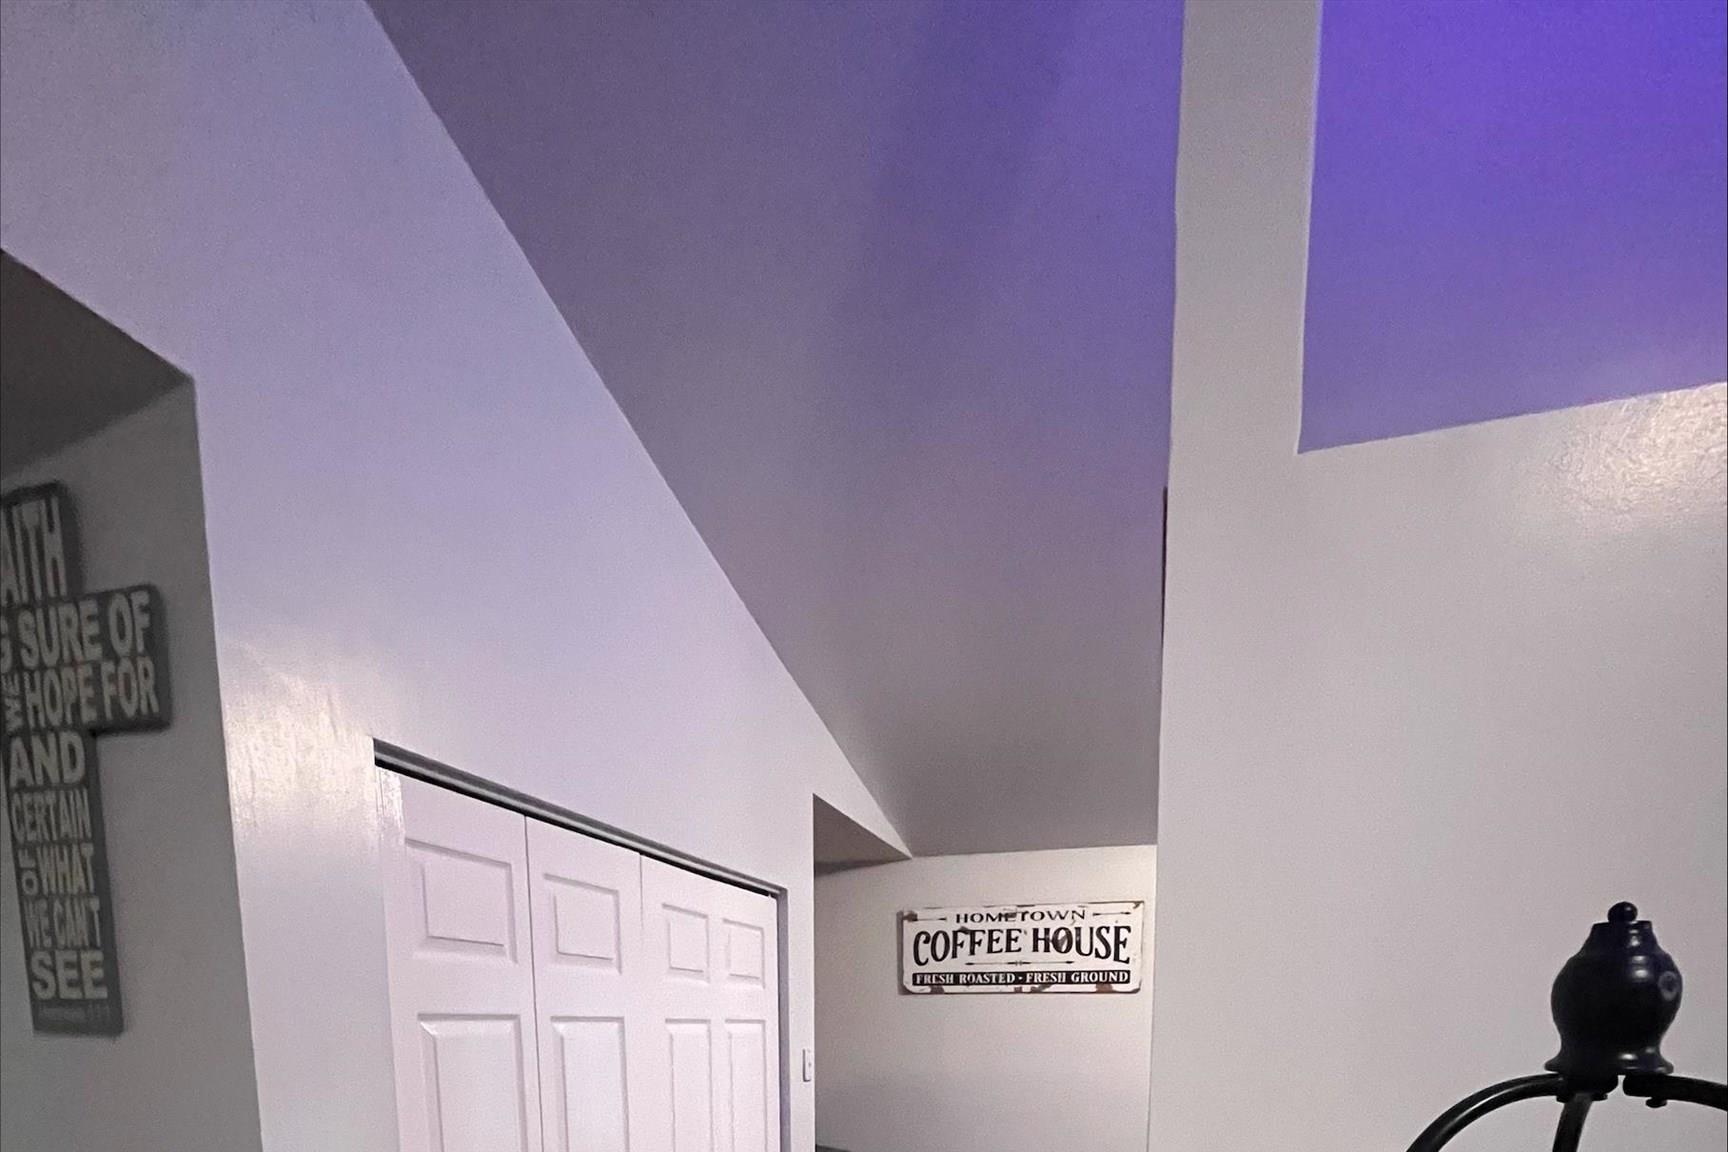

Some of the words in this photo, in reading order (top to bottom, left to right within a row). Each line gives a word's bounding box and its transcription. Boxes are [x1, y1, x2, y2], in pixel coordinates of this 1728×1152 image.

[0, 496, 67, 606] AITH
[18, 600, 101, 671] SURE
[108, 590, 150, 657] OF
[24, 662, 97, 735] HOPE
[101, 655, 159, 720] FOR
[9, 730, 86, 787] AND
[10, 787, 92, 843] CERTAIN
[36, 843, 95, 896] WHAT
[956, 909, 1085, 923] HOMETOWN
[913, 928, 1022, 967] COFFEE
[1032, 925, 1131, 965] HOUSE
[31, 950, 108, 1000] SEE
[916, 974, 954, 985] FRESH
[959, 972, 1016, 984] ROASTED
[1025, 971, 1066, 983] FRESH
[1070, 970, 1129, 983] GROUND
